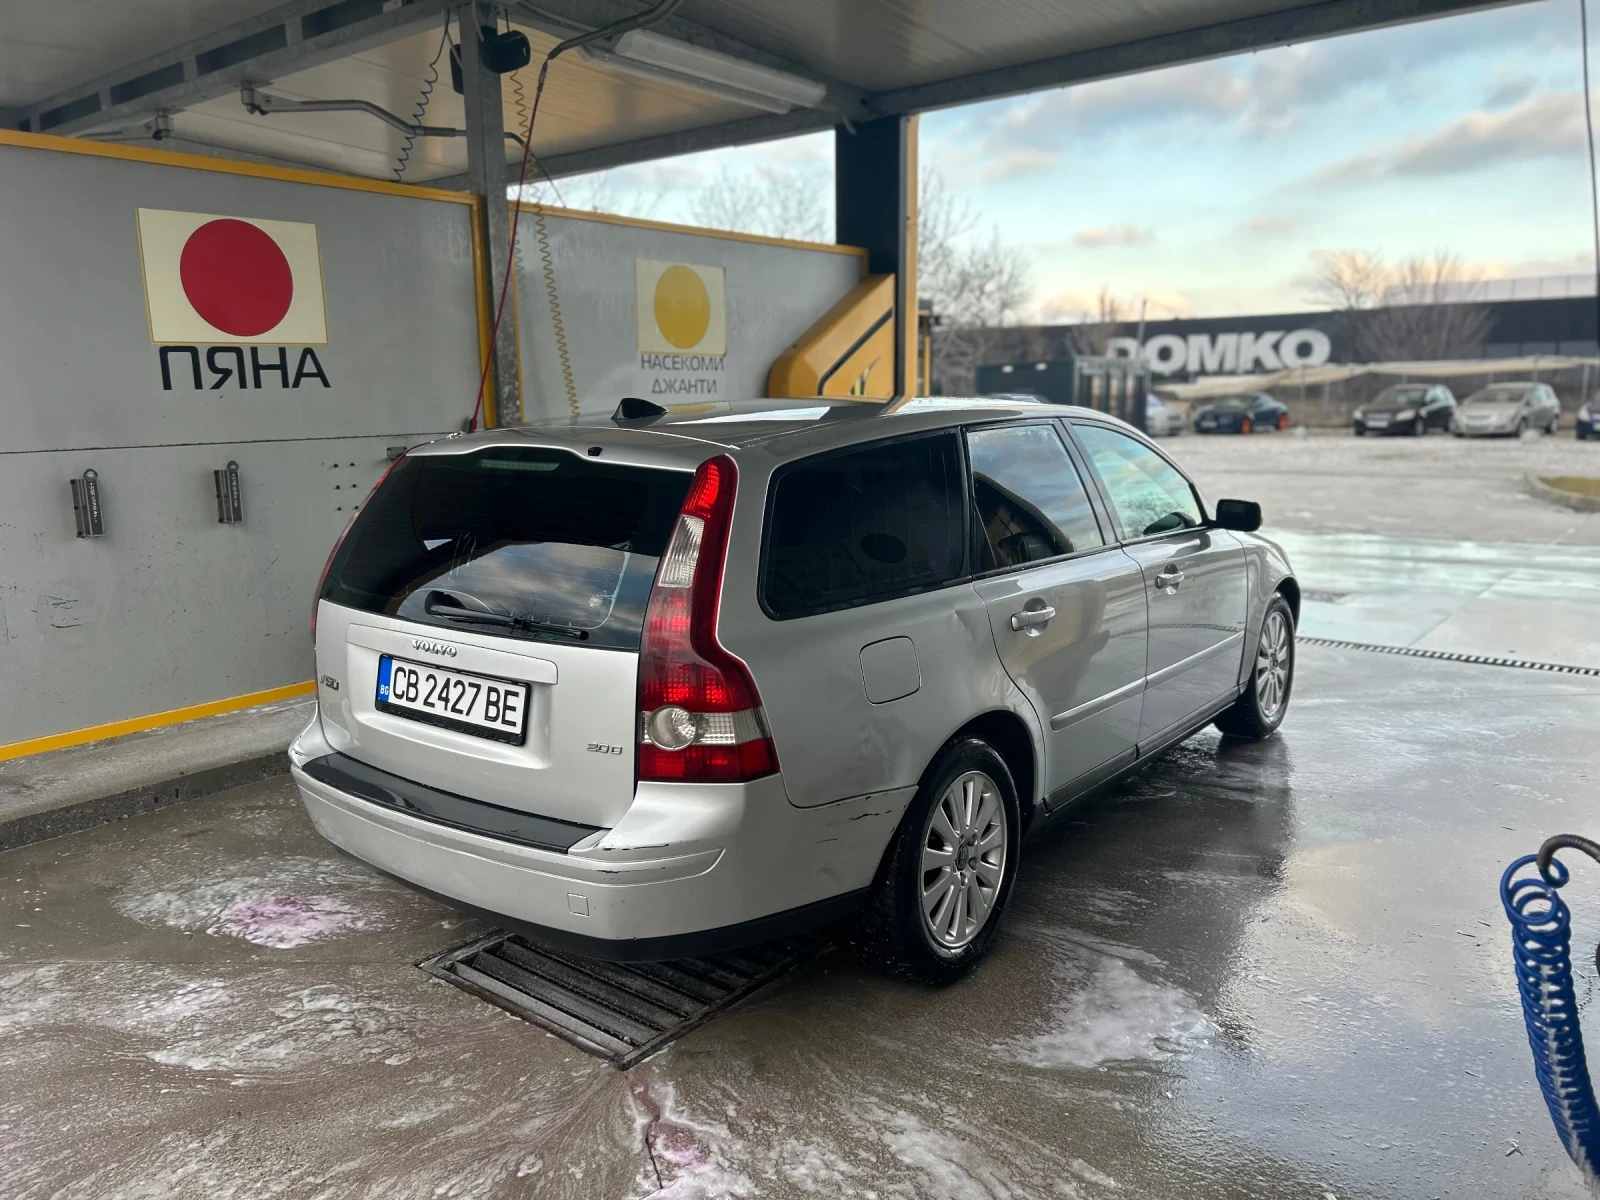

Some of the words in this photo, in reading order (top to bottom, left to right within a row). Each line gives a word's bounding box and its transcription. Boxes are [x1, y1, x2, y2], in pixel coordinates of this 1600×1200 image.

[159, 345, 331, 391] ПЯНА
[641, 355, 725, 372] НАСЕКОМИ
[652, 378, 717, 395] ДЖАНТИ
[411, 638, 458, 658] VOLVO
[319, 672, 340, 691] V50
[380, 684, 390, 697] BG
[393, 666, 419, 703] CB
[423, 674, 482, 717] 2427
[485, 686, 520, 727] BE
